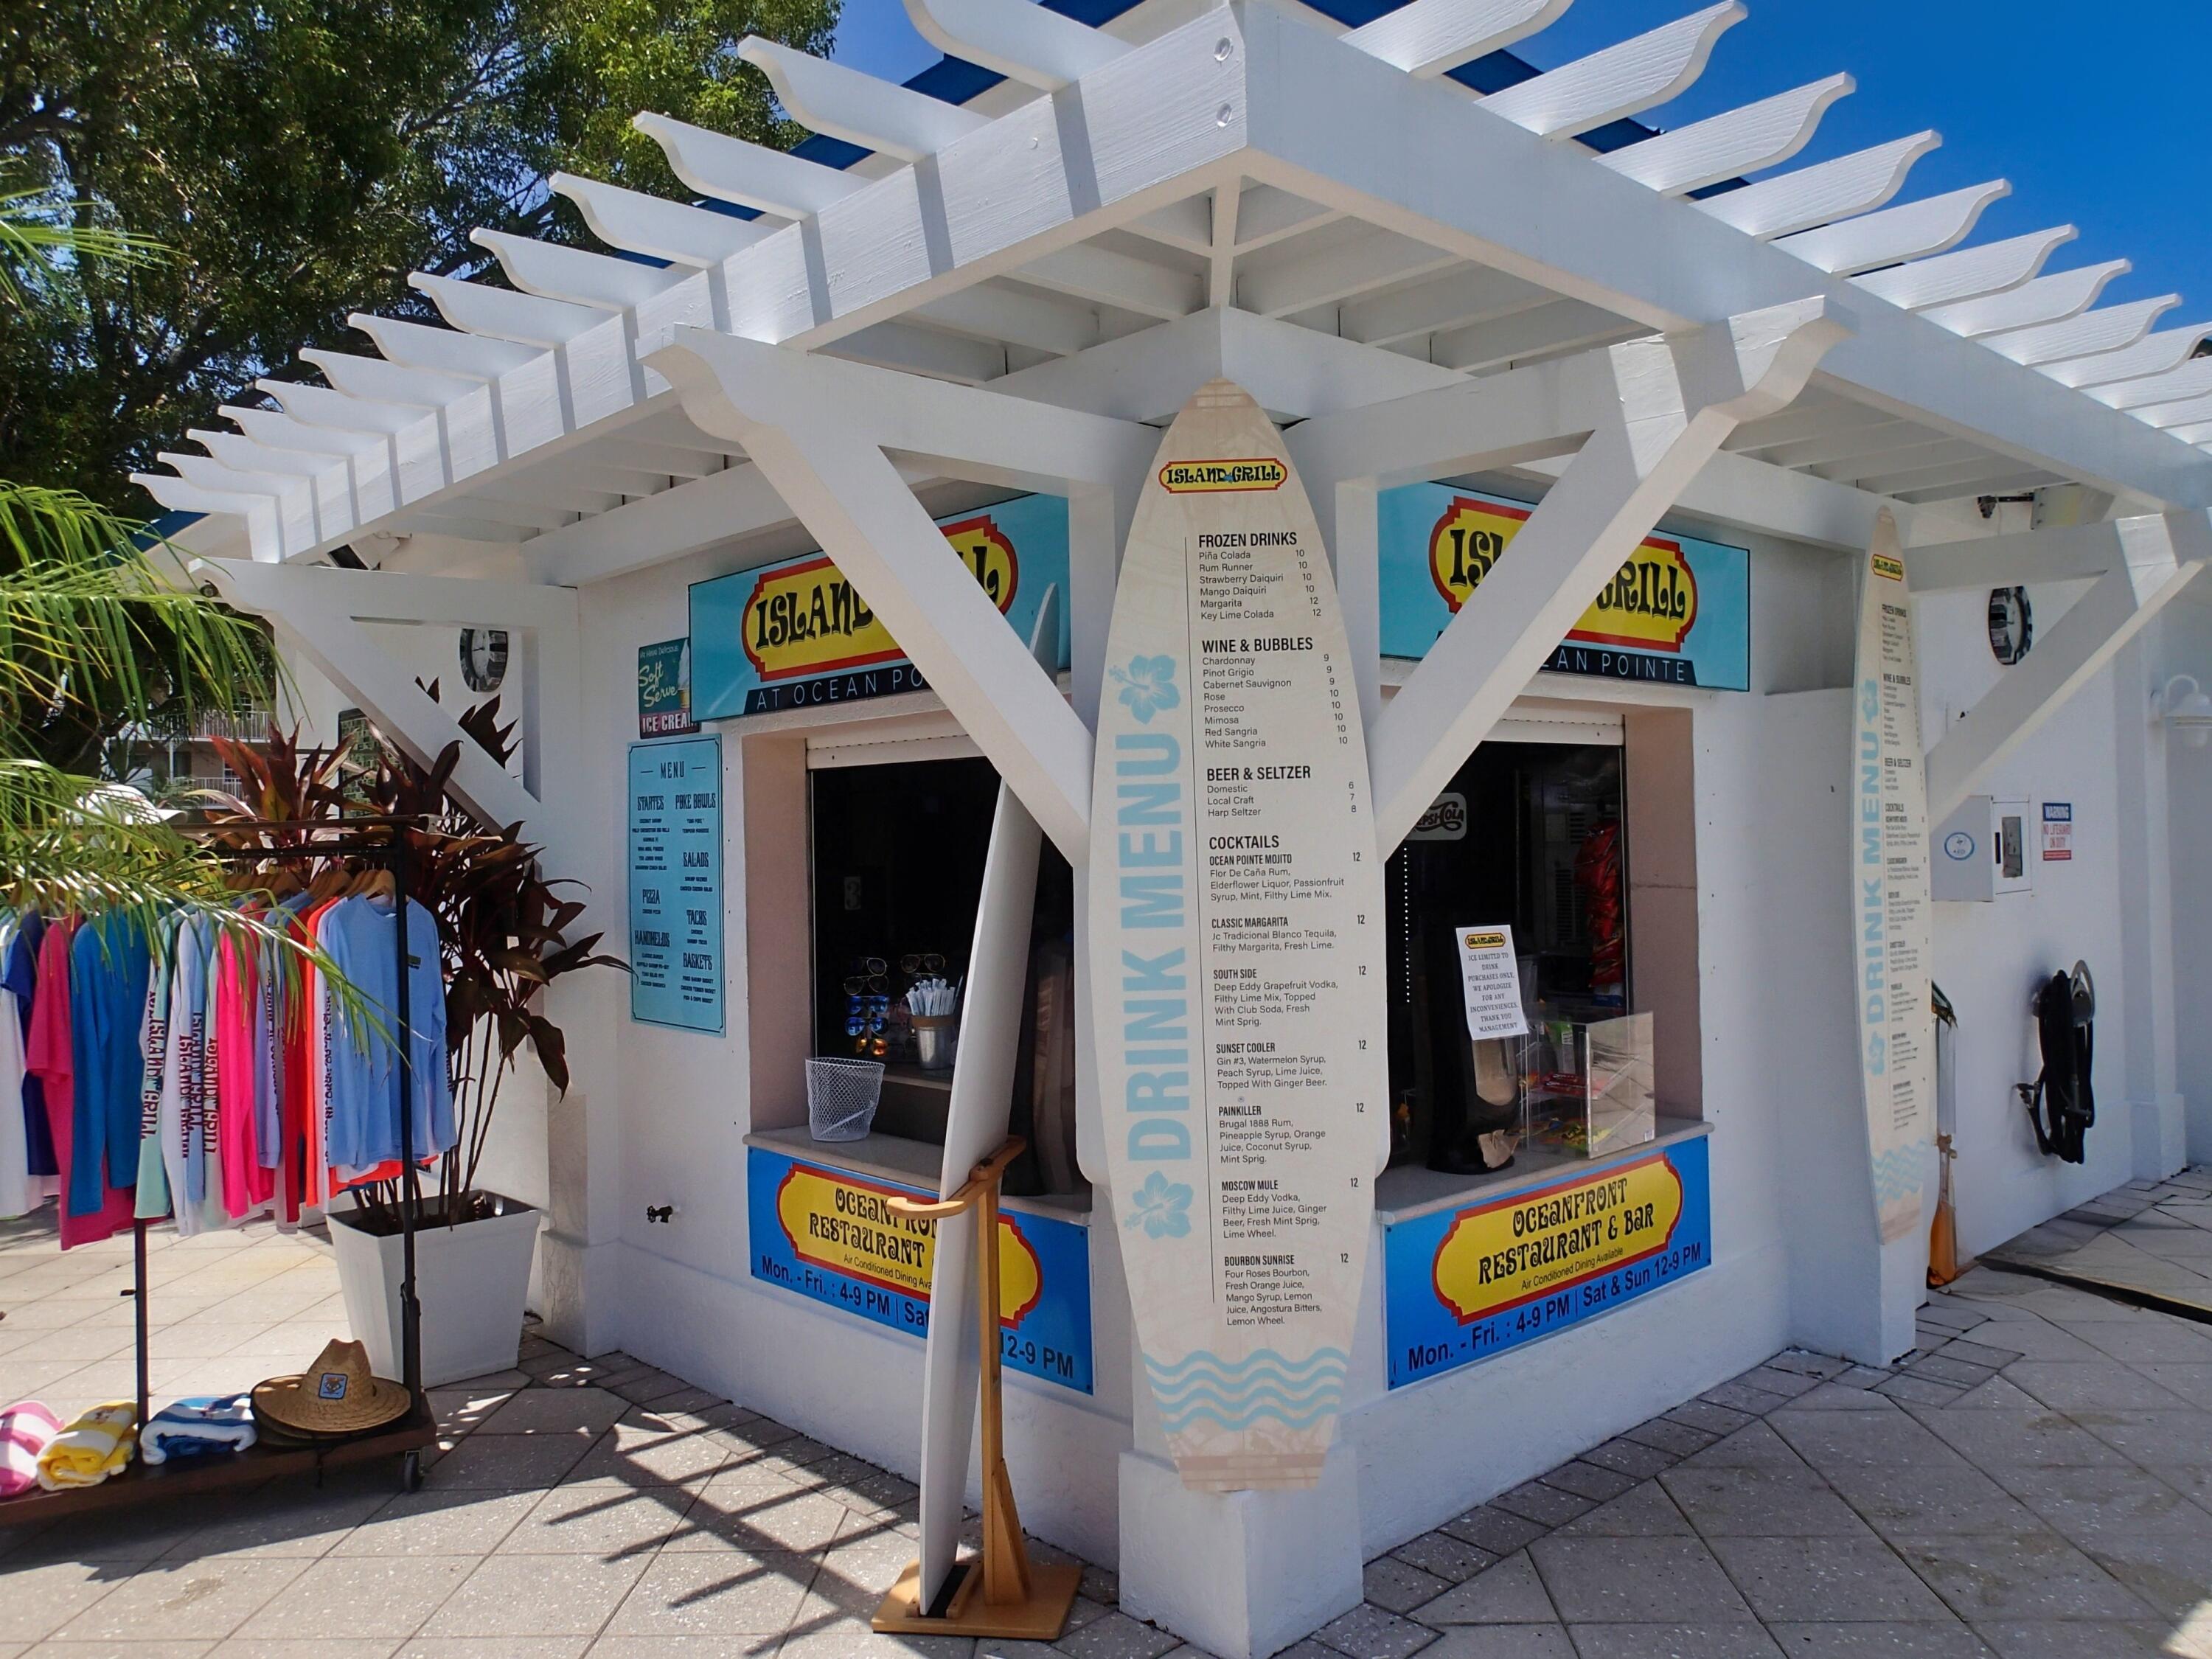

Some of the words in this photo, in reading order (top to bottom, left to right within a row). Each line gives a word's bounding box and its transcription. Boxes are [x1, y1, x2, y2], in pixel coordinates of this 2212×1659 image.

[1166, 466, 1226, 484] ISLAND
[1232, 465, 1280, 482] GRILL
[1199, 534, 1246, 548] FROZEN
[1250, 532, 1297, 546] DRINKS
[1199, 552, 1217, 560] Piña
[1220, 551, 1251, 559] Colada
[1200, 563, 1219, 572] Rum
[1222, 563, 1253, 571] Runner
[1299, 561, 1307, 569] 10
[1200, 574, 1247, 585] Strawberry
[1250, 574, 1284, 584] Daiquiri
[1303, 573, 1311, 581] 10
[1200, 587, 1231, 597] Mango
[1233, 586, 1266, 596] Daiquiri
[1306, 585, 1314, 593] 10
[1200, 599, 1242, 609] Margarita
[1310, 597, 1318, 605] 12
[1201, 612, 1217, 621] Key
[1220, 611, 1241, 619] Lime
[1244, 610, 1274, 619] Colada
[1202, 639, 1237, 653] WINE
[1240, 639, 1250, 652] &
[1254, 637, 1312, 651] BUBBLES
[1203, 656, 1255, 666] Chardonnay
[1324, 654, 1329, 662] 9
[1602, 653, 1684, 681] POINTE
[639, 661, 663, 687] Soft
[1203, 668, 1225, 677] Pinot
[1228, 667, 1254, 678] Grigio
[1327, 666, 1332, 674] 9
[1203, 680, 1243, 689] Cabernet
[1246, 678, 1292, 689] Sauvignon
[643, 685, 678, 708] Serve
[757, 689, 781, 710] AT
[794, 675, 877, 702] OCEAN
[1204, 692, 1225, 700] Rose
[1330, 689, 1338, 698] 10
[1205, 704, 1244, 712] Prosecco
[642, 716, 658, 733] ICE
[1205, 716, 1239, 724] Mimosa
[1206, 728, 1222, 737] Red
[1225, 727, 1257, 737] Sangria
[1337, 725, 1346, 733] 10
[1206, 740, 1231, 748] White
[1233, 739, 1266, 749] Sangria
[1339, 737, 1348, 745] 10
[661, 761, 684, 779] MENU
[1207, 768, 1239, 781] BEER
[1244, 768, 1253, 780] &
[1257, 766, 1311, 779] SELTZER
[1207, 785, 1248, 793] Domestic
[1208, 797, 1230, 805] Local
[1234, 796, 1254, 804] Craft
[1861, 731, 1880, 864] MENU
[1208, 809, 1229, 818] Harp
[1232, 808, 1261, 816] Seltzer
[1115, 737, 1186, 930] MENU
[1209, 835, 1279, 849] COCKTAILS
[1210, 856, 1234, 866] OCEAN
[1237, 855, 1262, 865] POINTE
[1265, 854, 1292, 864] MOJITO
[1353, 852, 1360, 862] 12
[1864, 878, 1885, 1024] DRINK
[147, 1019, 164, 1077] ISLAND
[1121, 947, 1193, 1163] DRINK
[141, 1091, 159, 1139] GRILL
[1513, 1178, 1627, 1237] OCEANFRONT
[810, 1212, 925, 1268] RESTAURANT
[1479, 1220, 1601, 1284] RESTAURANT
[1608, 1216, 1618, 1240] &
[1624, 1203, 1653, 1236] BAR
[1225, 1256, 1260, 1266] BOURBON
[1262, 1255, 1294, 1265] SUNRISE
[1340, 1253, 1349, 1262] 12
[855, 1257, 893, 1276] Conditioned
[896, 1270, 917, 1287] Dining
[1521, 1279, 1531, 1290] Air
[1534, 1265, 1573, 1287] Conditioned
[1576, 1257, 1595, 1273] Dining
[1596, 1247, 1623, 1264] Available
[1408, 1343, 1453, 1371] Mon.
[1472, 1322, 1499, 1349] Fri.
[1517, 1307, 1540, 1332] 4-9
[1546, 1295, 1569, 1322] PM
[1583, 1281, 1606, 1307] Sat
[1611, 1276, 1619, 1295] &
[1625, 1267, 1649, 1290] Sun
[1655, 1251, 1679, 1278] 12-9
[1683, 1242, 1700, 1266] PM
[762, 1256, 793, 1284] Mon.
[805, 1270, 827, 1295] Fri.
[840, 1282, 861, 1306] 4-9
[867, 1290, 890, 1315] PM
[1043, 1346, 1073, 1379] PM
